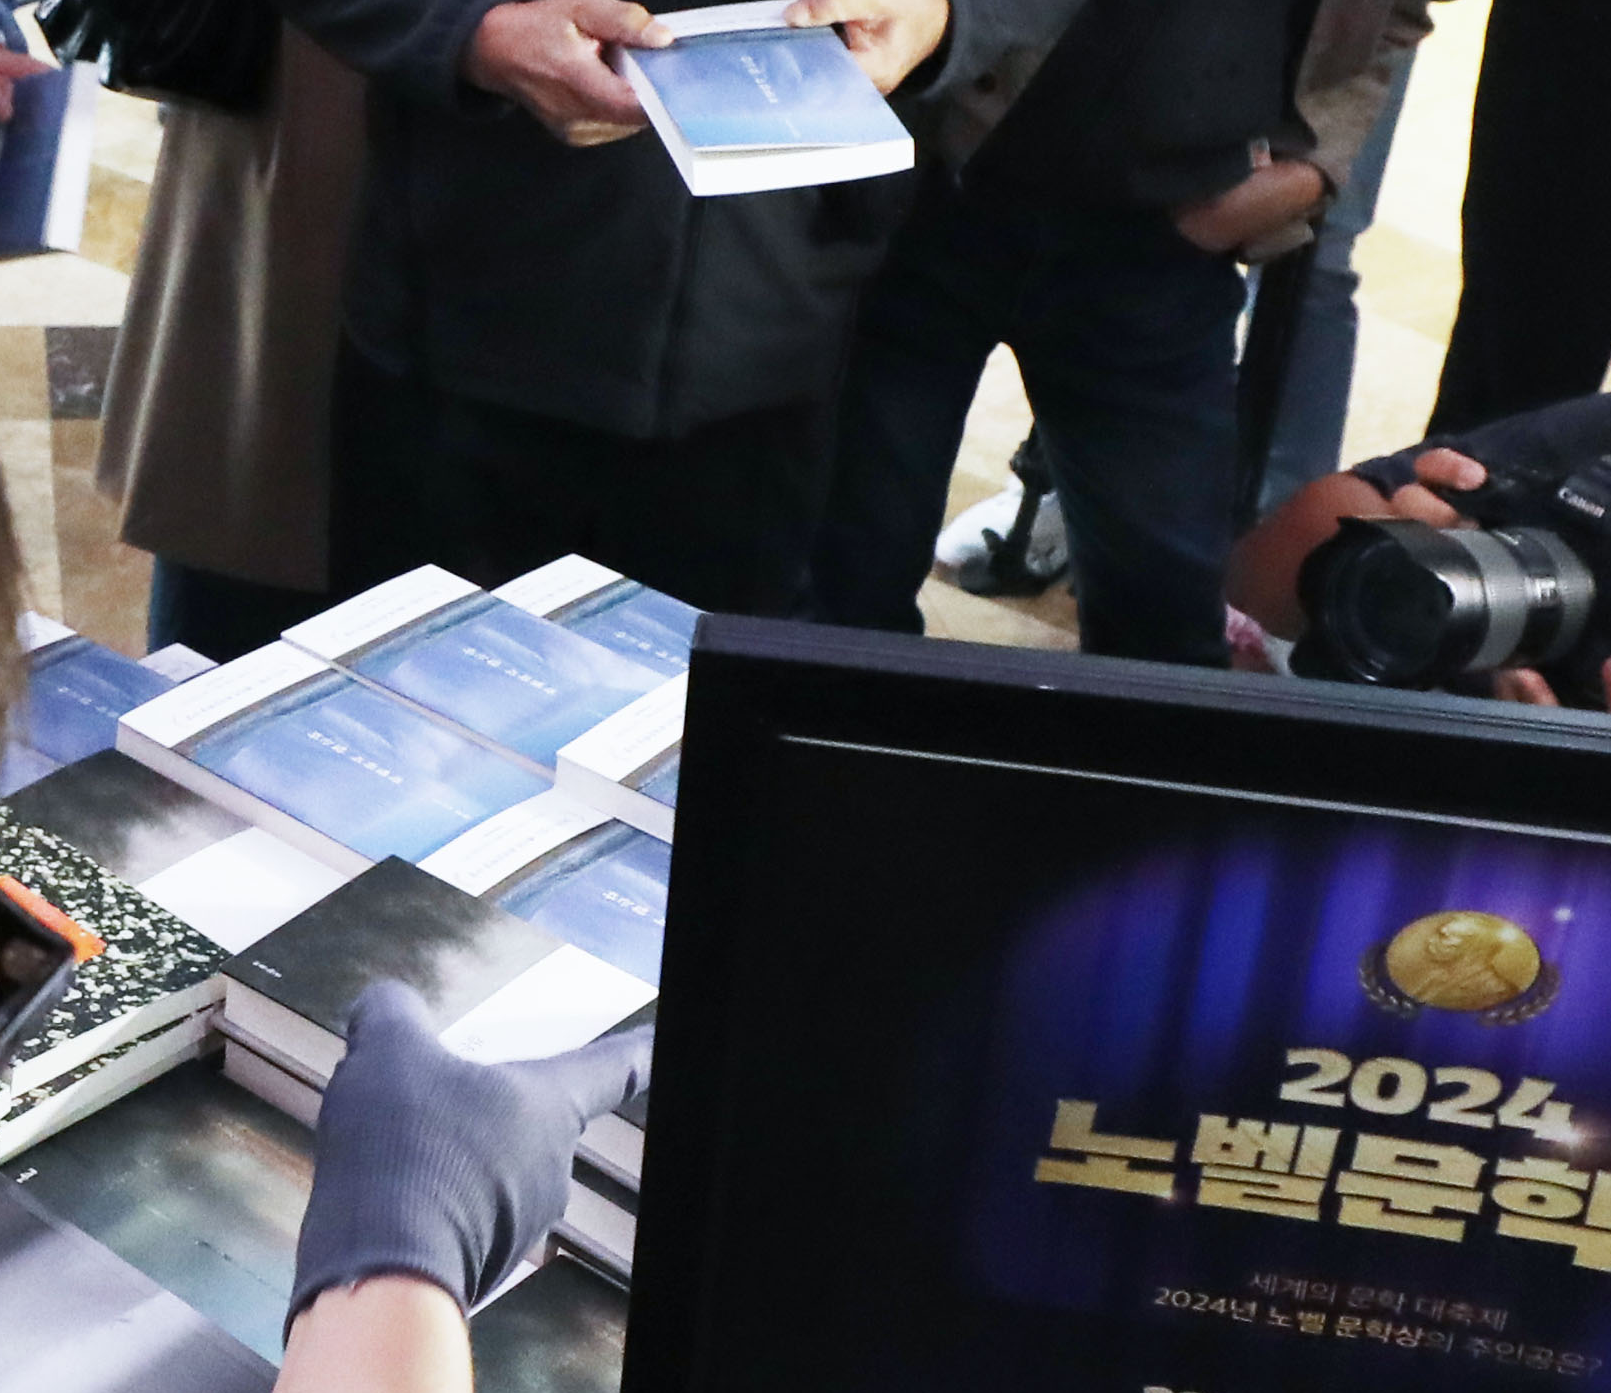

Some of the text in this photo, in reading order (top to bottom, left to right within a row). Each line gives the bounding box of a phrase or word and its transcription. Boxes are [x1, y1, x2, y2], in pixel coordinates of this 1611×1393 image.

[1557, 485, 1607, 519] Canon
[1277, 1047, 1577, 1147] 2024
[1152, 1285, 1602, 1377] 2024년 노벨 문학상의 주인공은?
[1250, 1270, 1509, 1331] 세계의 문학 대축제
